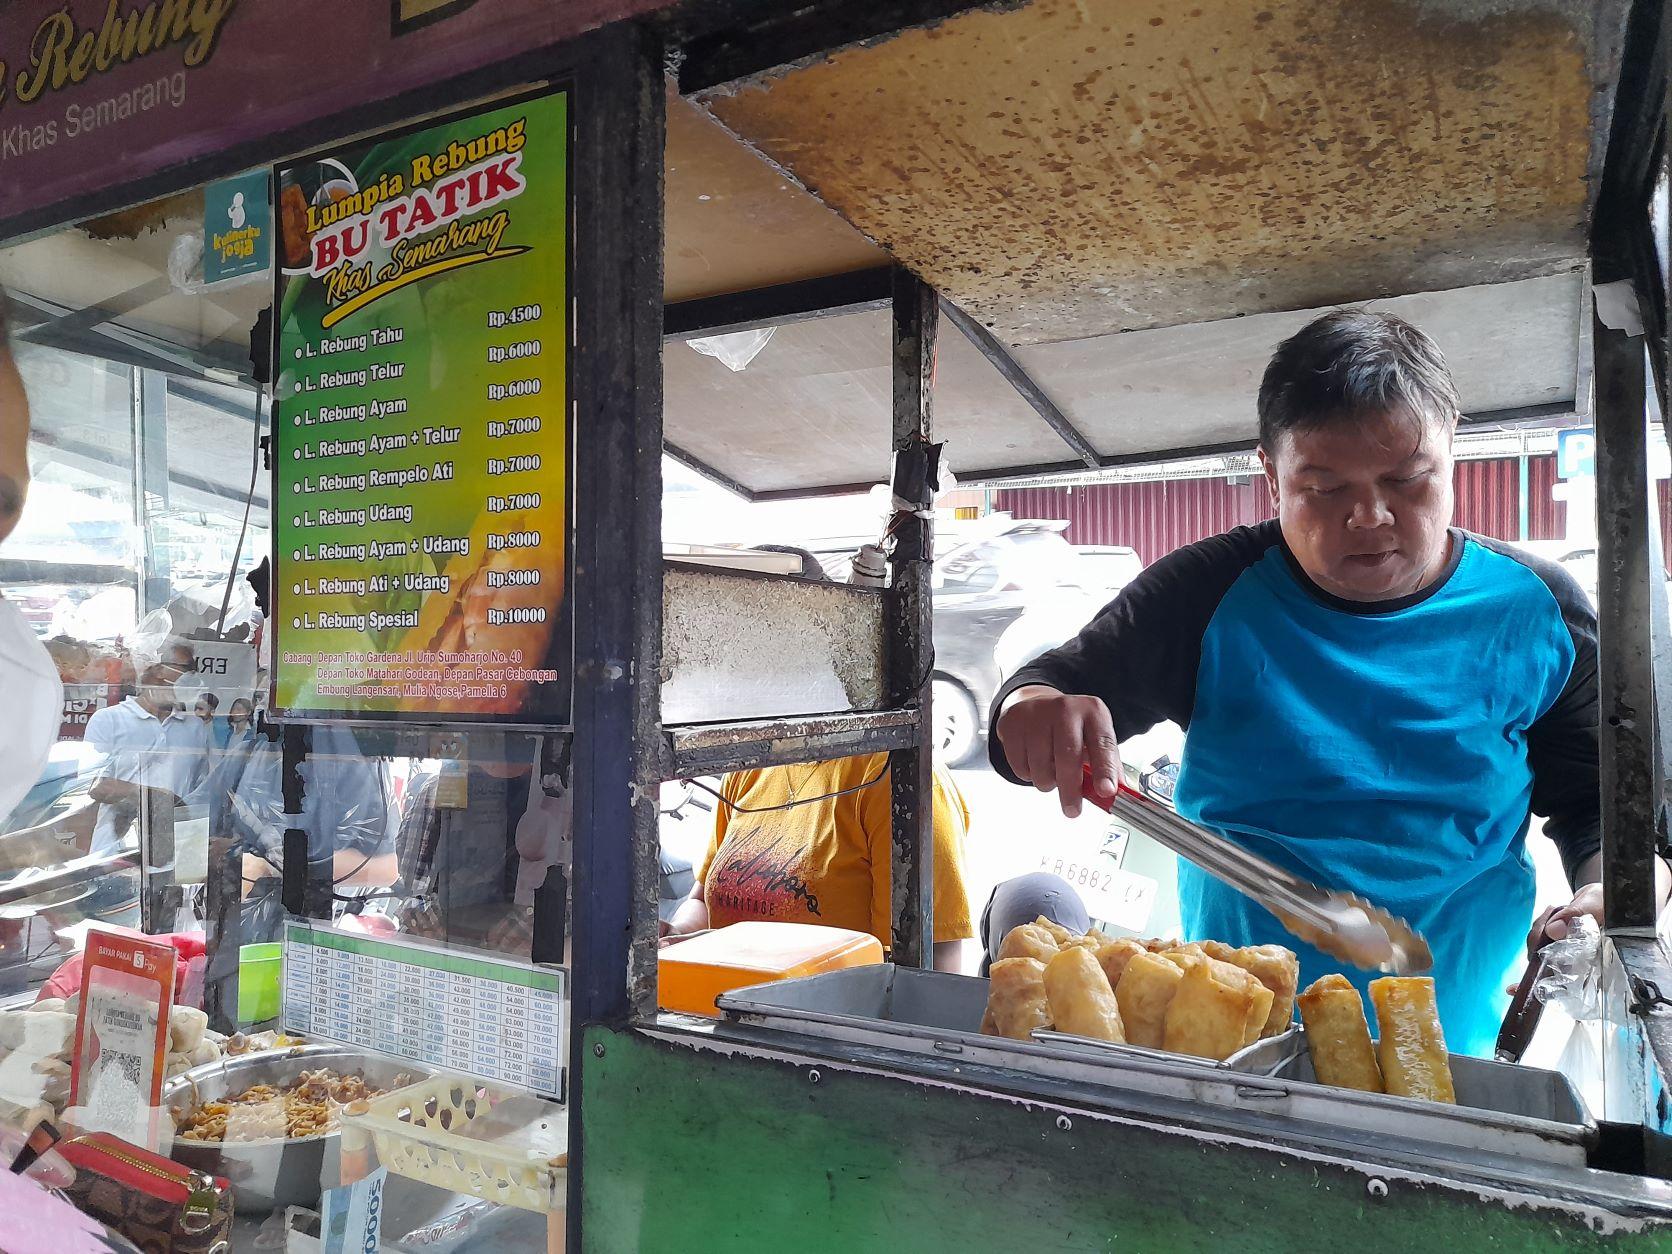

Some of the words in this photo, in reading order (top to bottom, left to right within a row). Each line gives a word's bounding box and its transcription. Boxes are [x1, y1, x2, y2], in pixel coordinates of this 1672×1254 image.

[16, 0, 236, 101] Rebung
[2, 119, 58, 159] Khas
[65, 71, 187, 138] Semarang
[305, 172, 405, 233] Lumpia
[411, 117, 526, 187] Rebung
[314, 219, 370, 271] BU
[379, 157, 521, 241] TATIK
[322, 261, 371, 304] Khas
[377, 210, 510, 281] Semarang
[306, 343, 316, 356] L.
[321, 336, 366, 354] Rebung
[371, 327, 403, 345] Tahu
[488, 305, 541, 326] Rp.4500
[306, 377, 315, 390] L.
[321, 370, 366, 389] Rebung
[371, 363, 404, 380] Telur
[488, 341, 540, 362] Rp.6000
[305, 411, 315, 424] L.
[320, 404, 365, 422] Rebung
[370, 398, 406, 418] Ayam
[488, 379, 540, 400] Rp.6000
[305, 445, 315, 459] L.
[320, 438, 365, 456] Rebung
[370, 433, 406, 452] Ayam
[411, 432, 419, 444] +
[423, 427, 460, 444] Telur
[488, 417, 540, 437] Rp.7000
[1565, 434, 1594, 472] P
[305, 478, 315, 492] L.
[320, 473, 365, 491] Rebung
[370, 466, 427, 488] Rempelo
[433, 462, 453, 480] Ati
[488, 456, 540, 475] Rp.7000
[305, 512, 315, 526] L.
[320, 507, 365, 526] Rebung
[370, 505, 412, 523] Udang
[488, 494, 540, 512] Rp.7000
[305, 547, 315, 560] L.
[320, 543, 365, 561] Rebung
[369, 541, 405, 558] Ayam
[411, 541, 419, 552] +
[424, 537, 469, 555] Udang
[488, 532, 540, 550] Rp.8000
[305, 580, 315, 594] L.
[320, 578, 364, 596] Rebung
[369, 575, 387, 592] Ati
[393, 578, 400, 589] +
[405, 575, 449, 593] Udang
[488, 570, 539, 587] Rp.8000
[305, 614, 314, 628] L.
[320, 612, 364, 631] Rebung
[369, 610, 418, 631] Spesial
[488, 609, 545, 625] Rp.10000
[284, 652, 312, 665] Cabang
[318, 651, 342, 664] Depan
[345, 651, 365, 663] Toko
[366, 651, 402, 663] Gardena
[417, 650, 436, 664] Urip
[438, 650, 489, 665] Sumoharjo
[491, 650, 508, 663] No.
[510, 649, 522, 663] 40
[317, 668, 342, 681] Depan
[345, 668, 364, 679] Toko
[366, 668, 403, 679] Matahari
[444, 668, 474, 681] Depan
[476, 668, 504, 680] Pasar
[506, 667, 557, 684] Cebongan
[317, 684, 350, 698] Embung
[403, 684, 427, 697] Mulia
[500, 685, 507, 698] 6
[1067, 864, 1112, 892] 6882
[98, 946, 116, 957] BAYAR
[144, 959, 157, 973] Pay
[454, 975, 472, 984] 31.500
[506, 985, 524, 994] 40.500
[506, 996, 524, 1005] 54.000
[506, 1007, 524, 1016] 54.000
[533, 1024, 552, 1033] 70.000
[533, 1035, 552, 1044] 70.000
[504, 1050, 523, 1060] 72.000
[533, 1046, 552, 1056] 70.000
[504, 1061, 522, 1071] 72.000
[504, 1072, 522, 1082] 90.000
